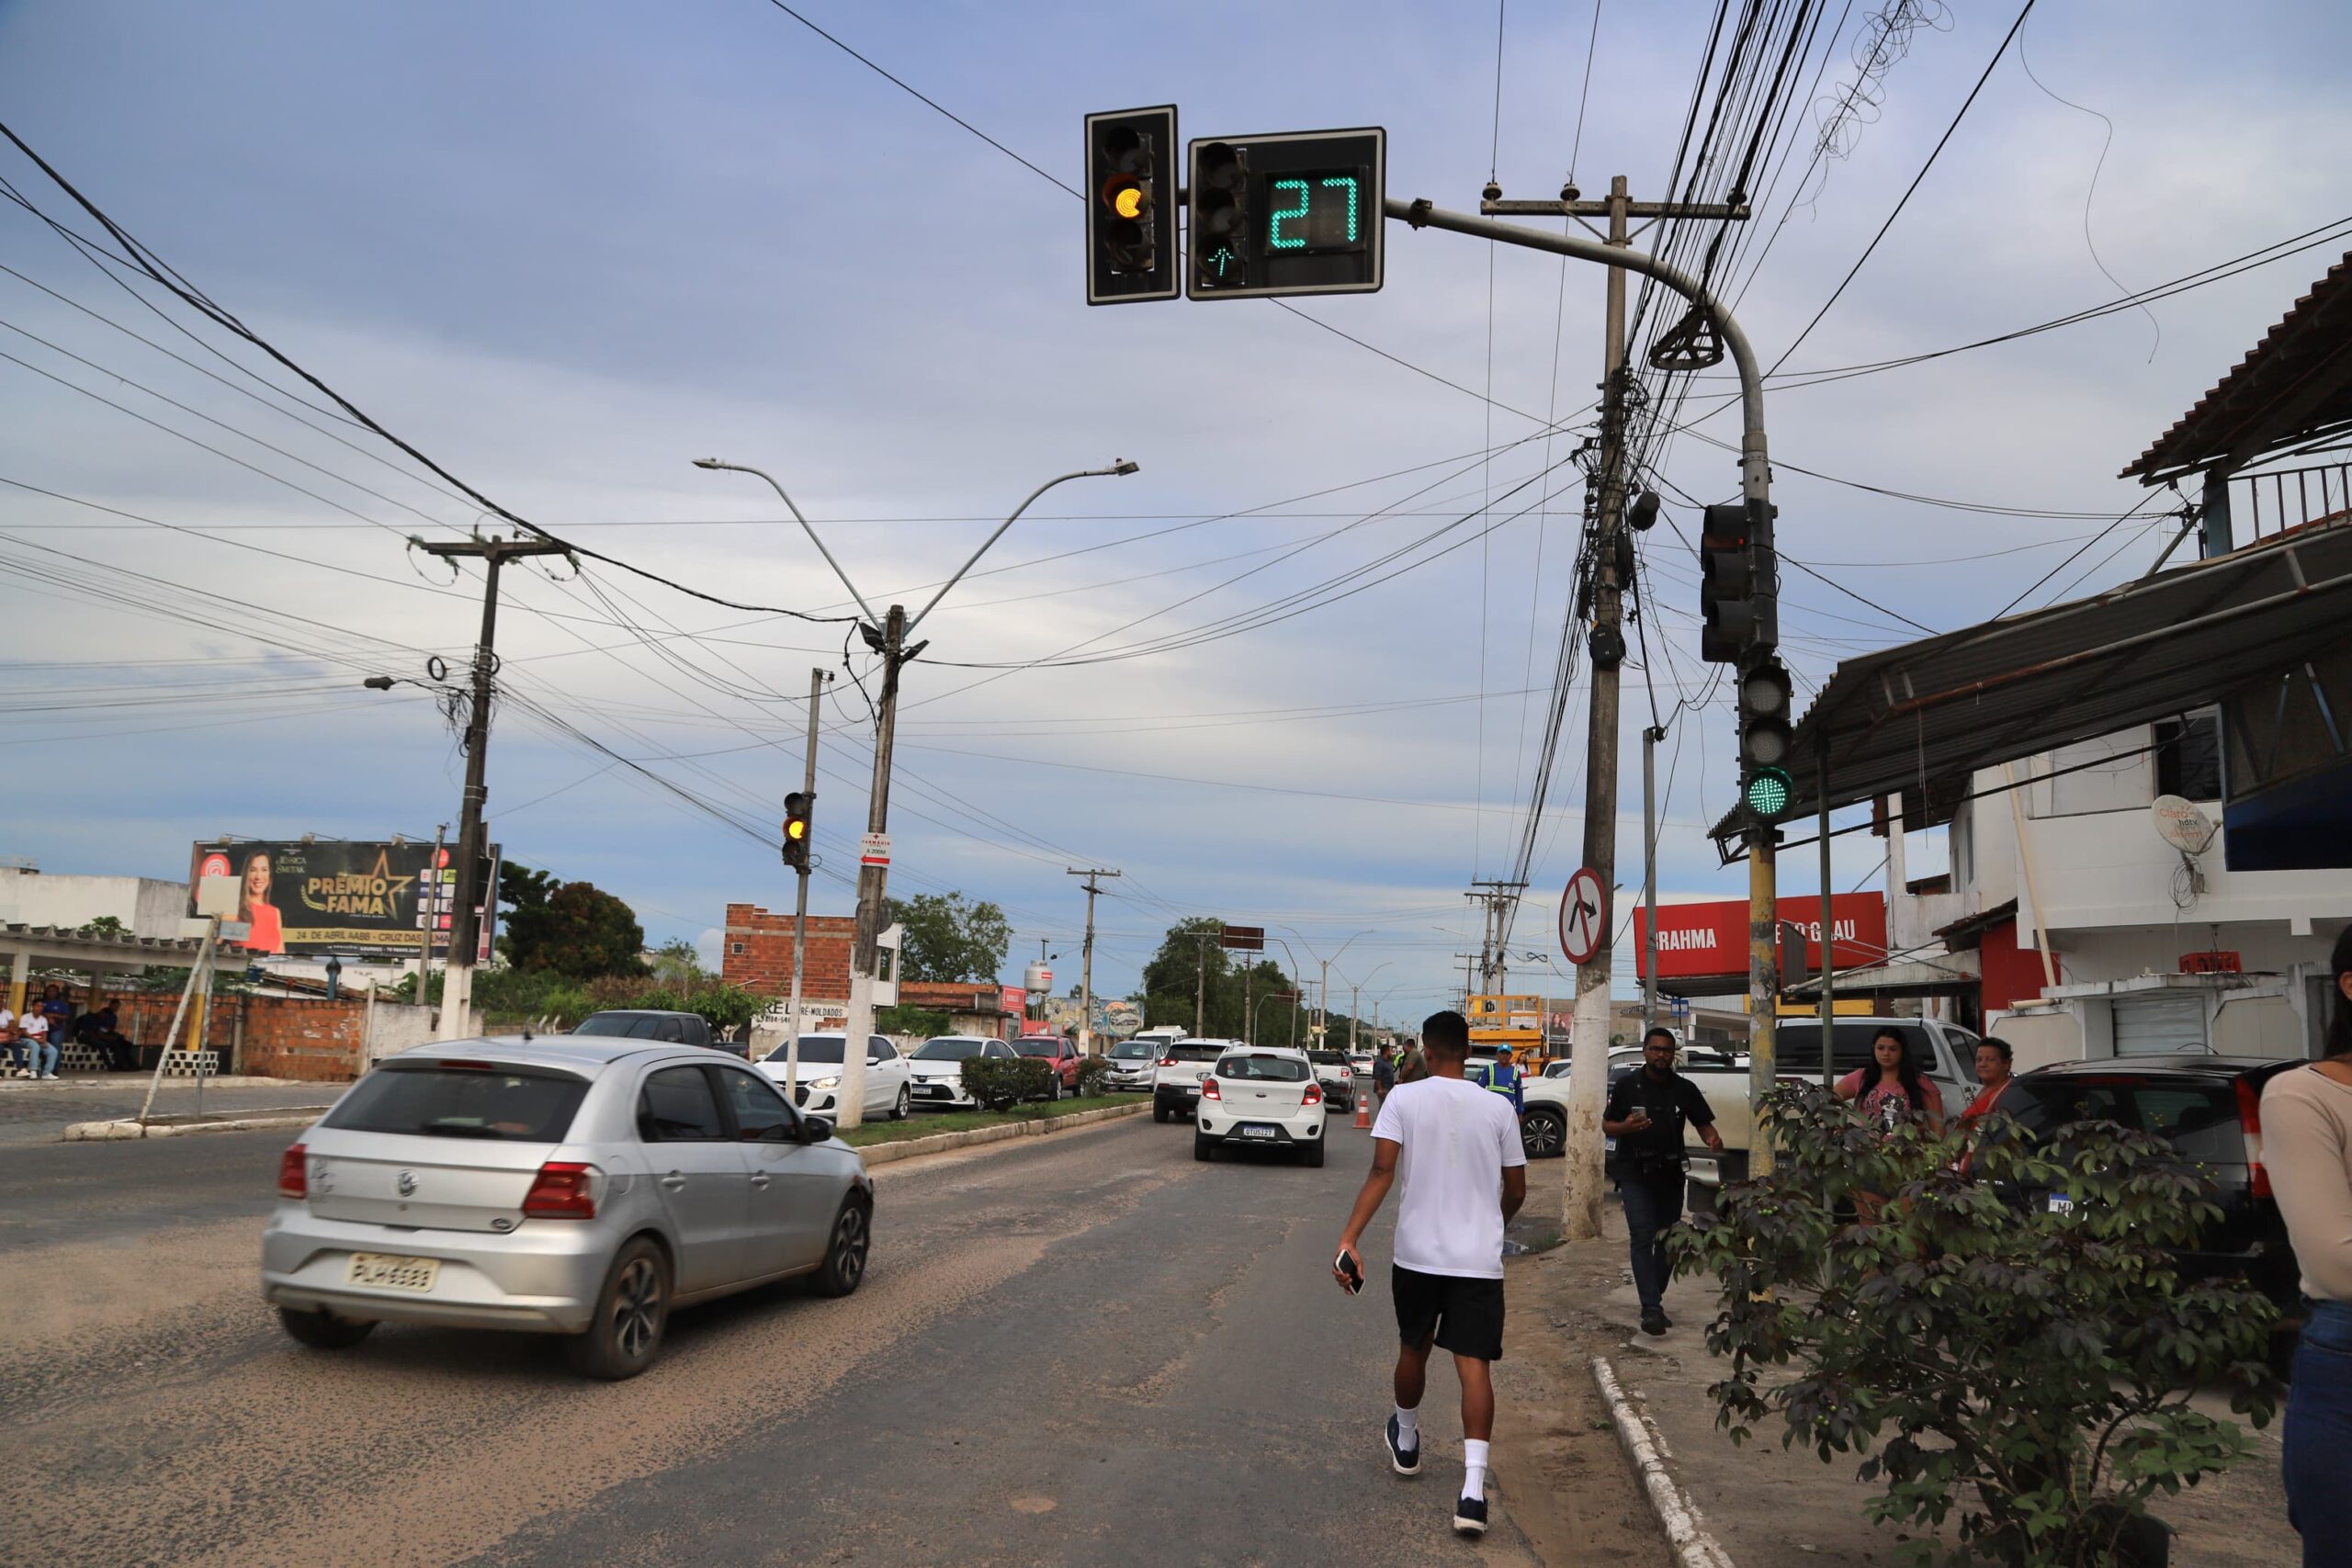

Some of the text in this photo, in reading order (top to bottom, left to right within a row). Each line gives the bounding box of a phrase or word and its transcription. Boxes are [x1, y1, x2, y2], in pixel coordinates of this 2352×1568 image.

[1272, 176, 1357, 249] 27
[326, 896, 384, 914] FAMA
[311, 931, 322, 940] DE
[324, 931, 345, 940] ABRIL
[379, 933, 402, 942] CRUZ
[404, 933, 422, 942] DAS
